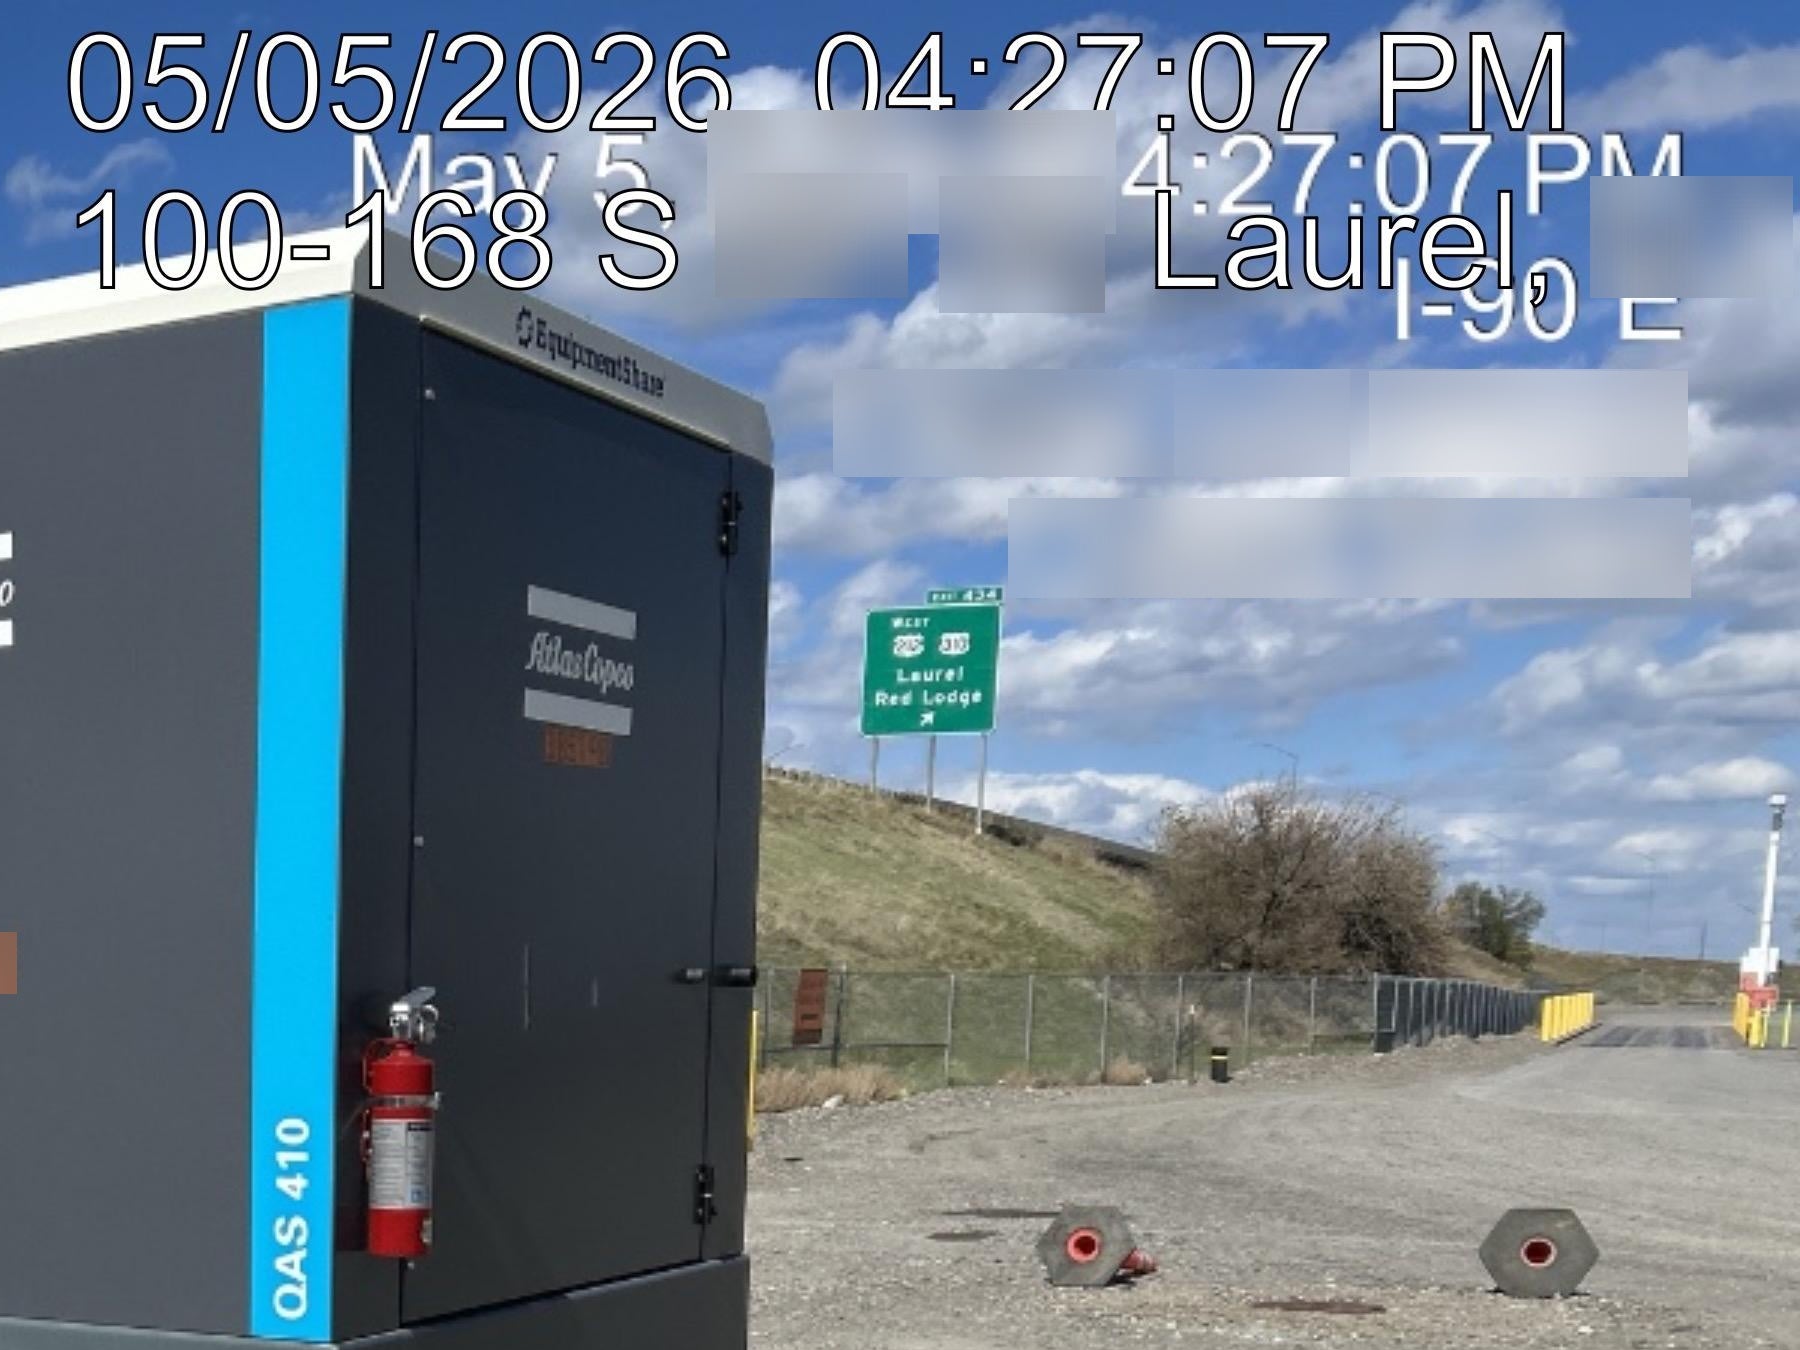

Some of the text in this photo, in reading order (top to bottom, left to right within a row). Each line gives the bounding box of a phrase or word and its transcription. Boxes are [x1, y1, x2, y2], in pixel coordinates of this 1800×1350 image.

[536, 317, 665, 398] EquipmentShare
[525, 631, 634, 694] Atlas Copco
[896, 665, 965, 684] Laurel
[875, 688, 983, 709] Red Lodge
[273, 1117, 311, 1320] QAS 410
